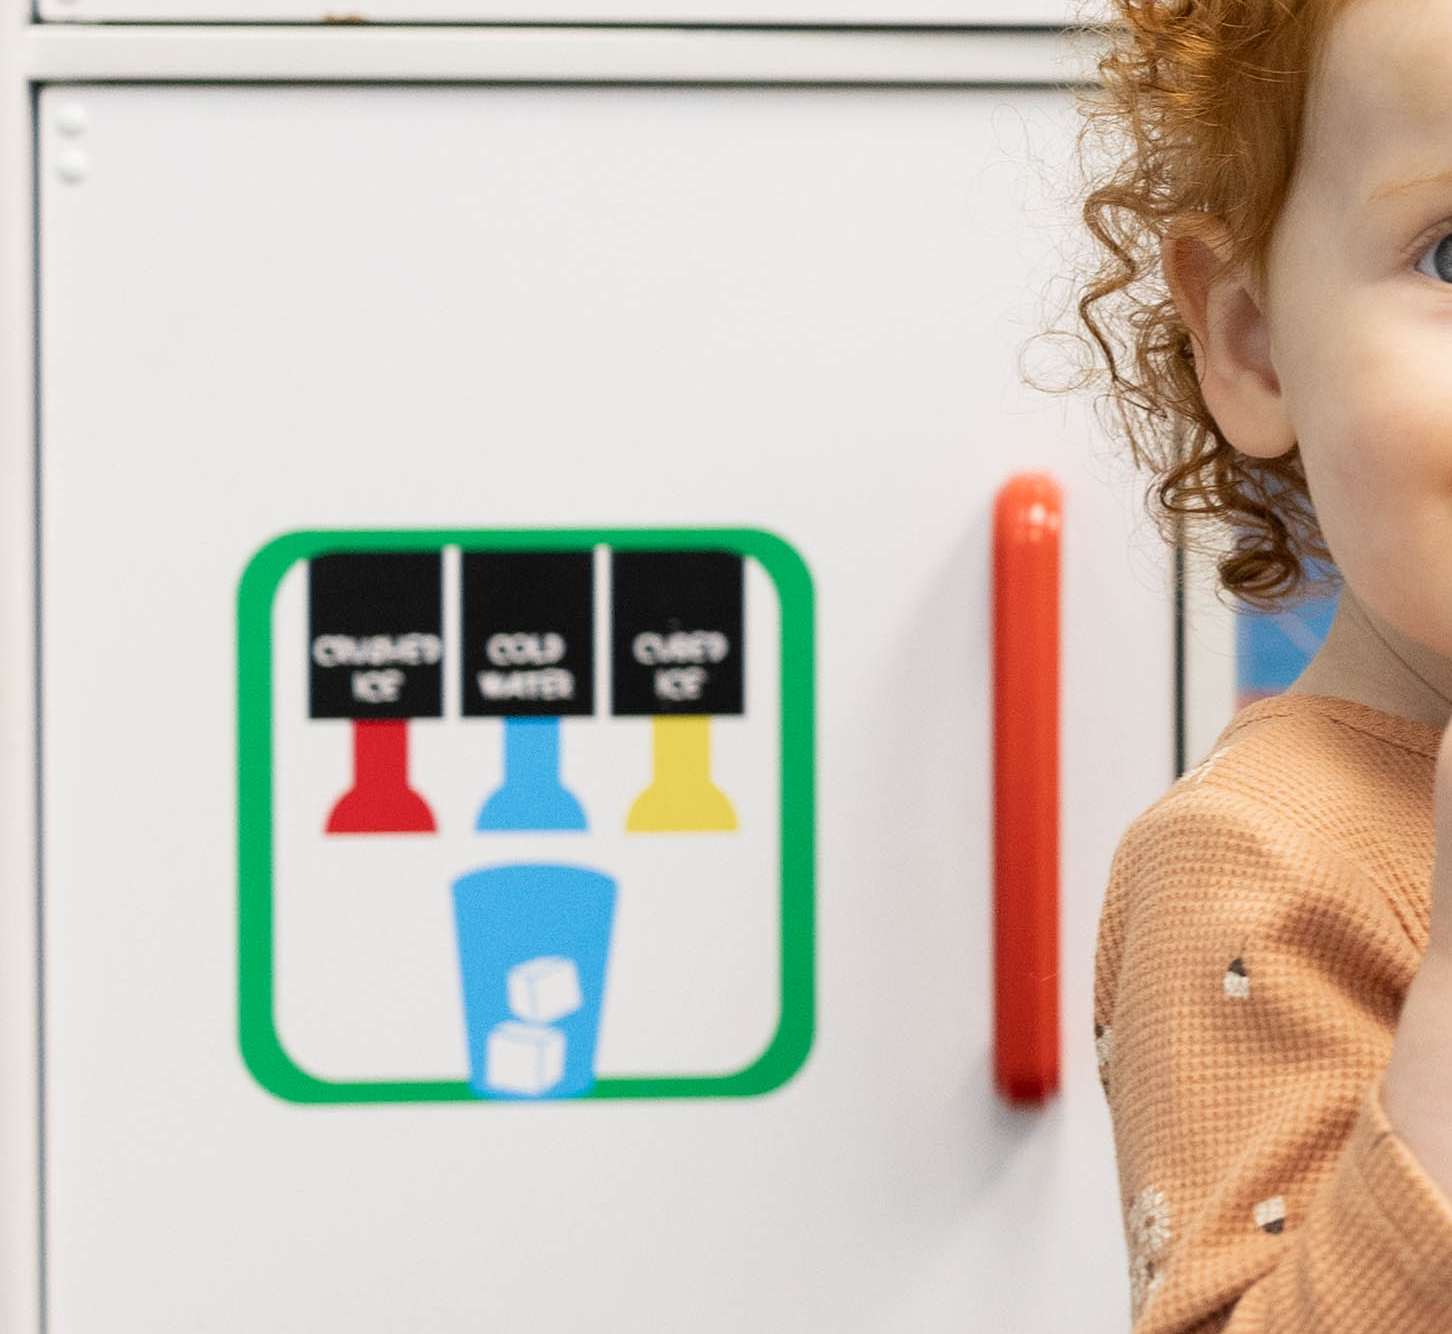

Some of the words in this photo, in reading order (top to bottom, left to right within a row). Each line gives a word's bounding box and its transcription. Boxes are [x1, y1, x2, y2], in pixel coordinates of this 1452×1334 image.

[486, 632, 566, 667] COLD
[351, 669, 406, 703] ICE
[477, 668, 575, 701] WATER
[653, 667, 707, 700] ICE
